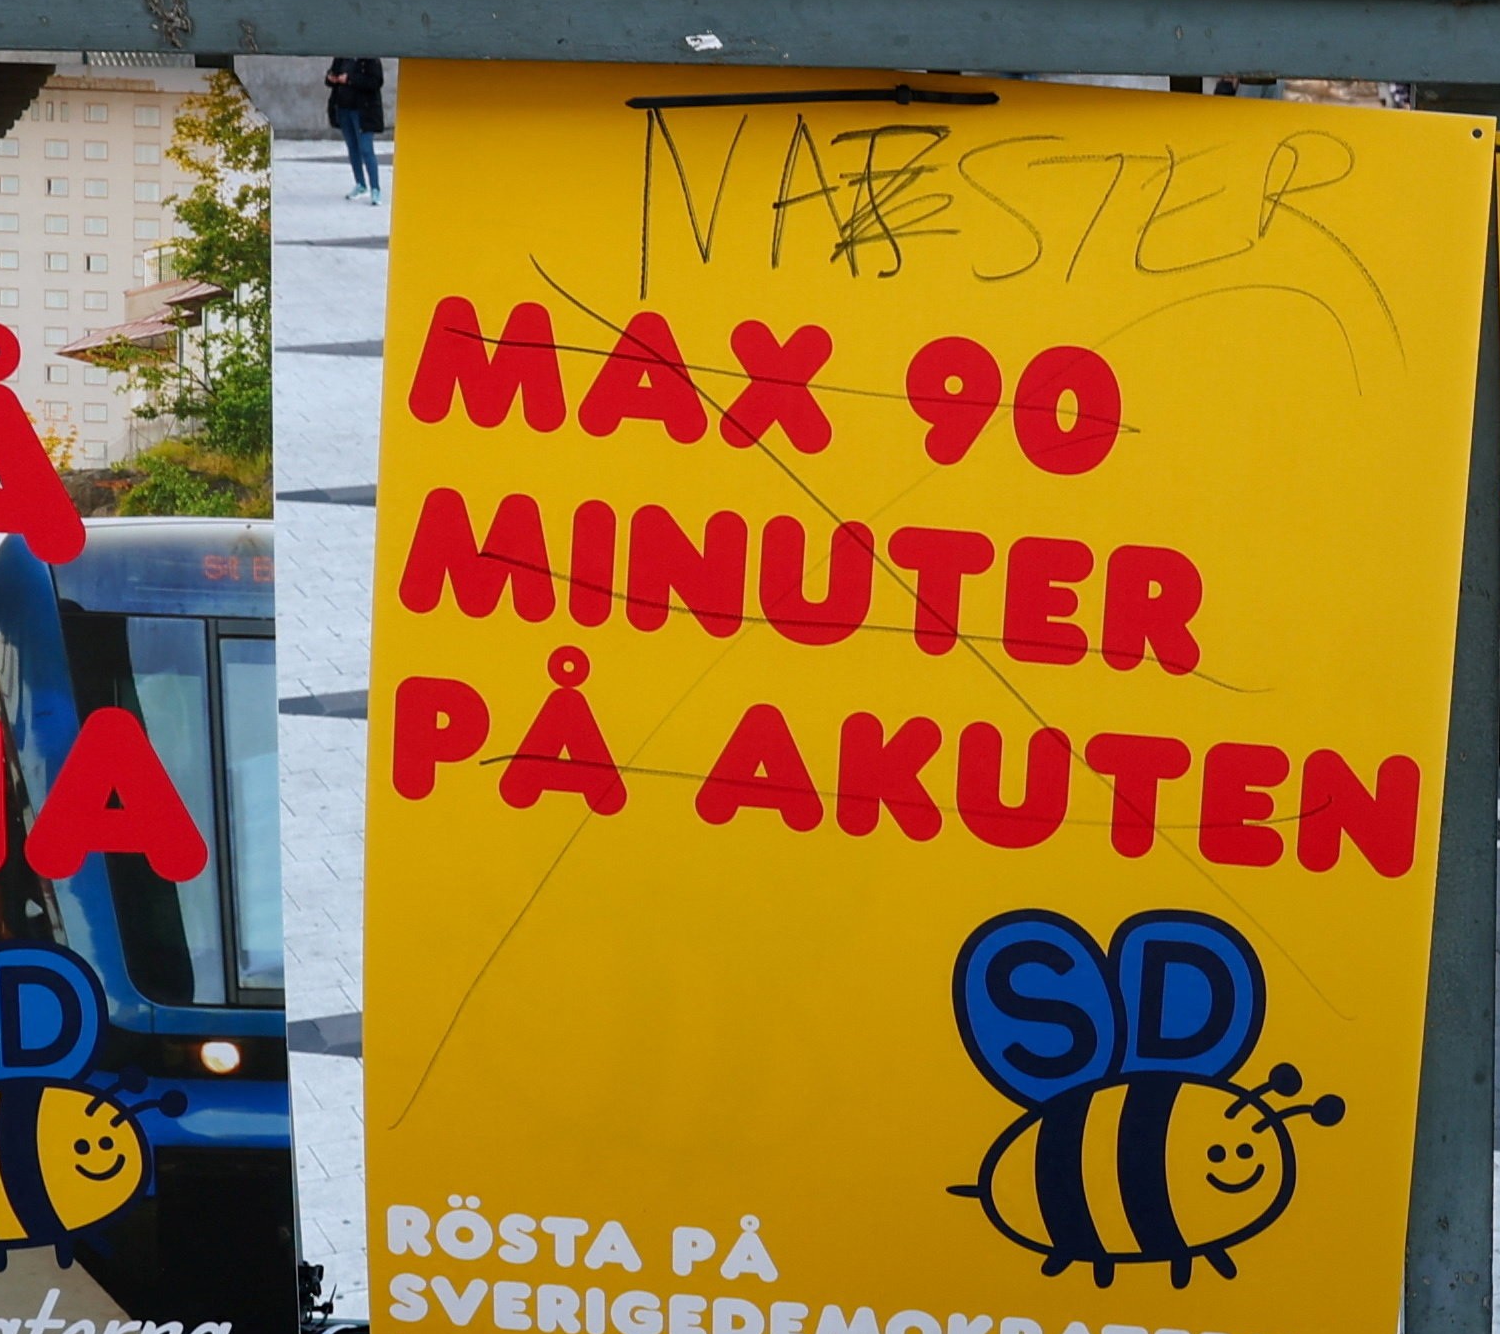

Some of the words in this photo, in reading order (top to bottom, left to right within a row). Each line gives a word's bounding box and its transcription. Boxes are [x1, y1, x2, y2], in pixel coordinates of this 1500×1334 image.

[408, 295, 834, 457] MAX
[904, 335, 1122, 477] 90
[398, 486, 1204, 677] MINUTER
[391, 644, 628, 817] PÅ
[694, 701, 1421, 878] AKUTEN
[985, 937, 1237, 1081] SD
[385, 1192, 643, 1273] RÖSTA
[672, 1214, 779, 1283] PÅ
